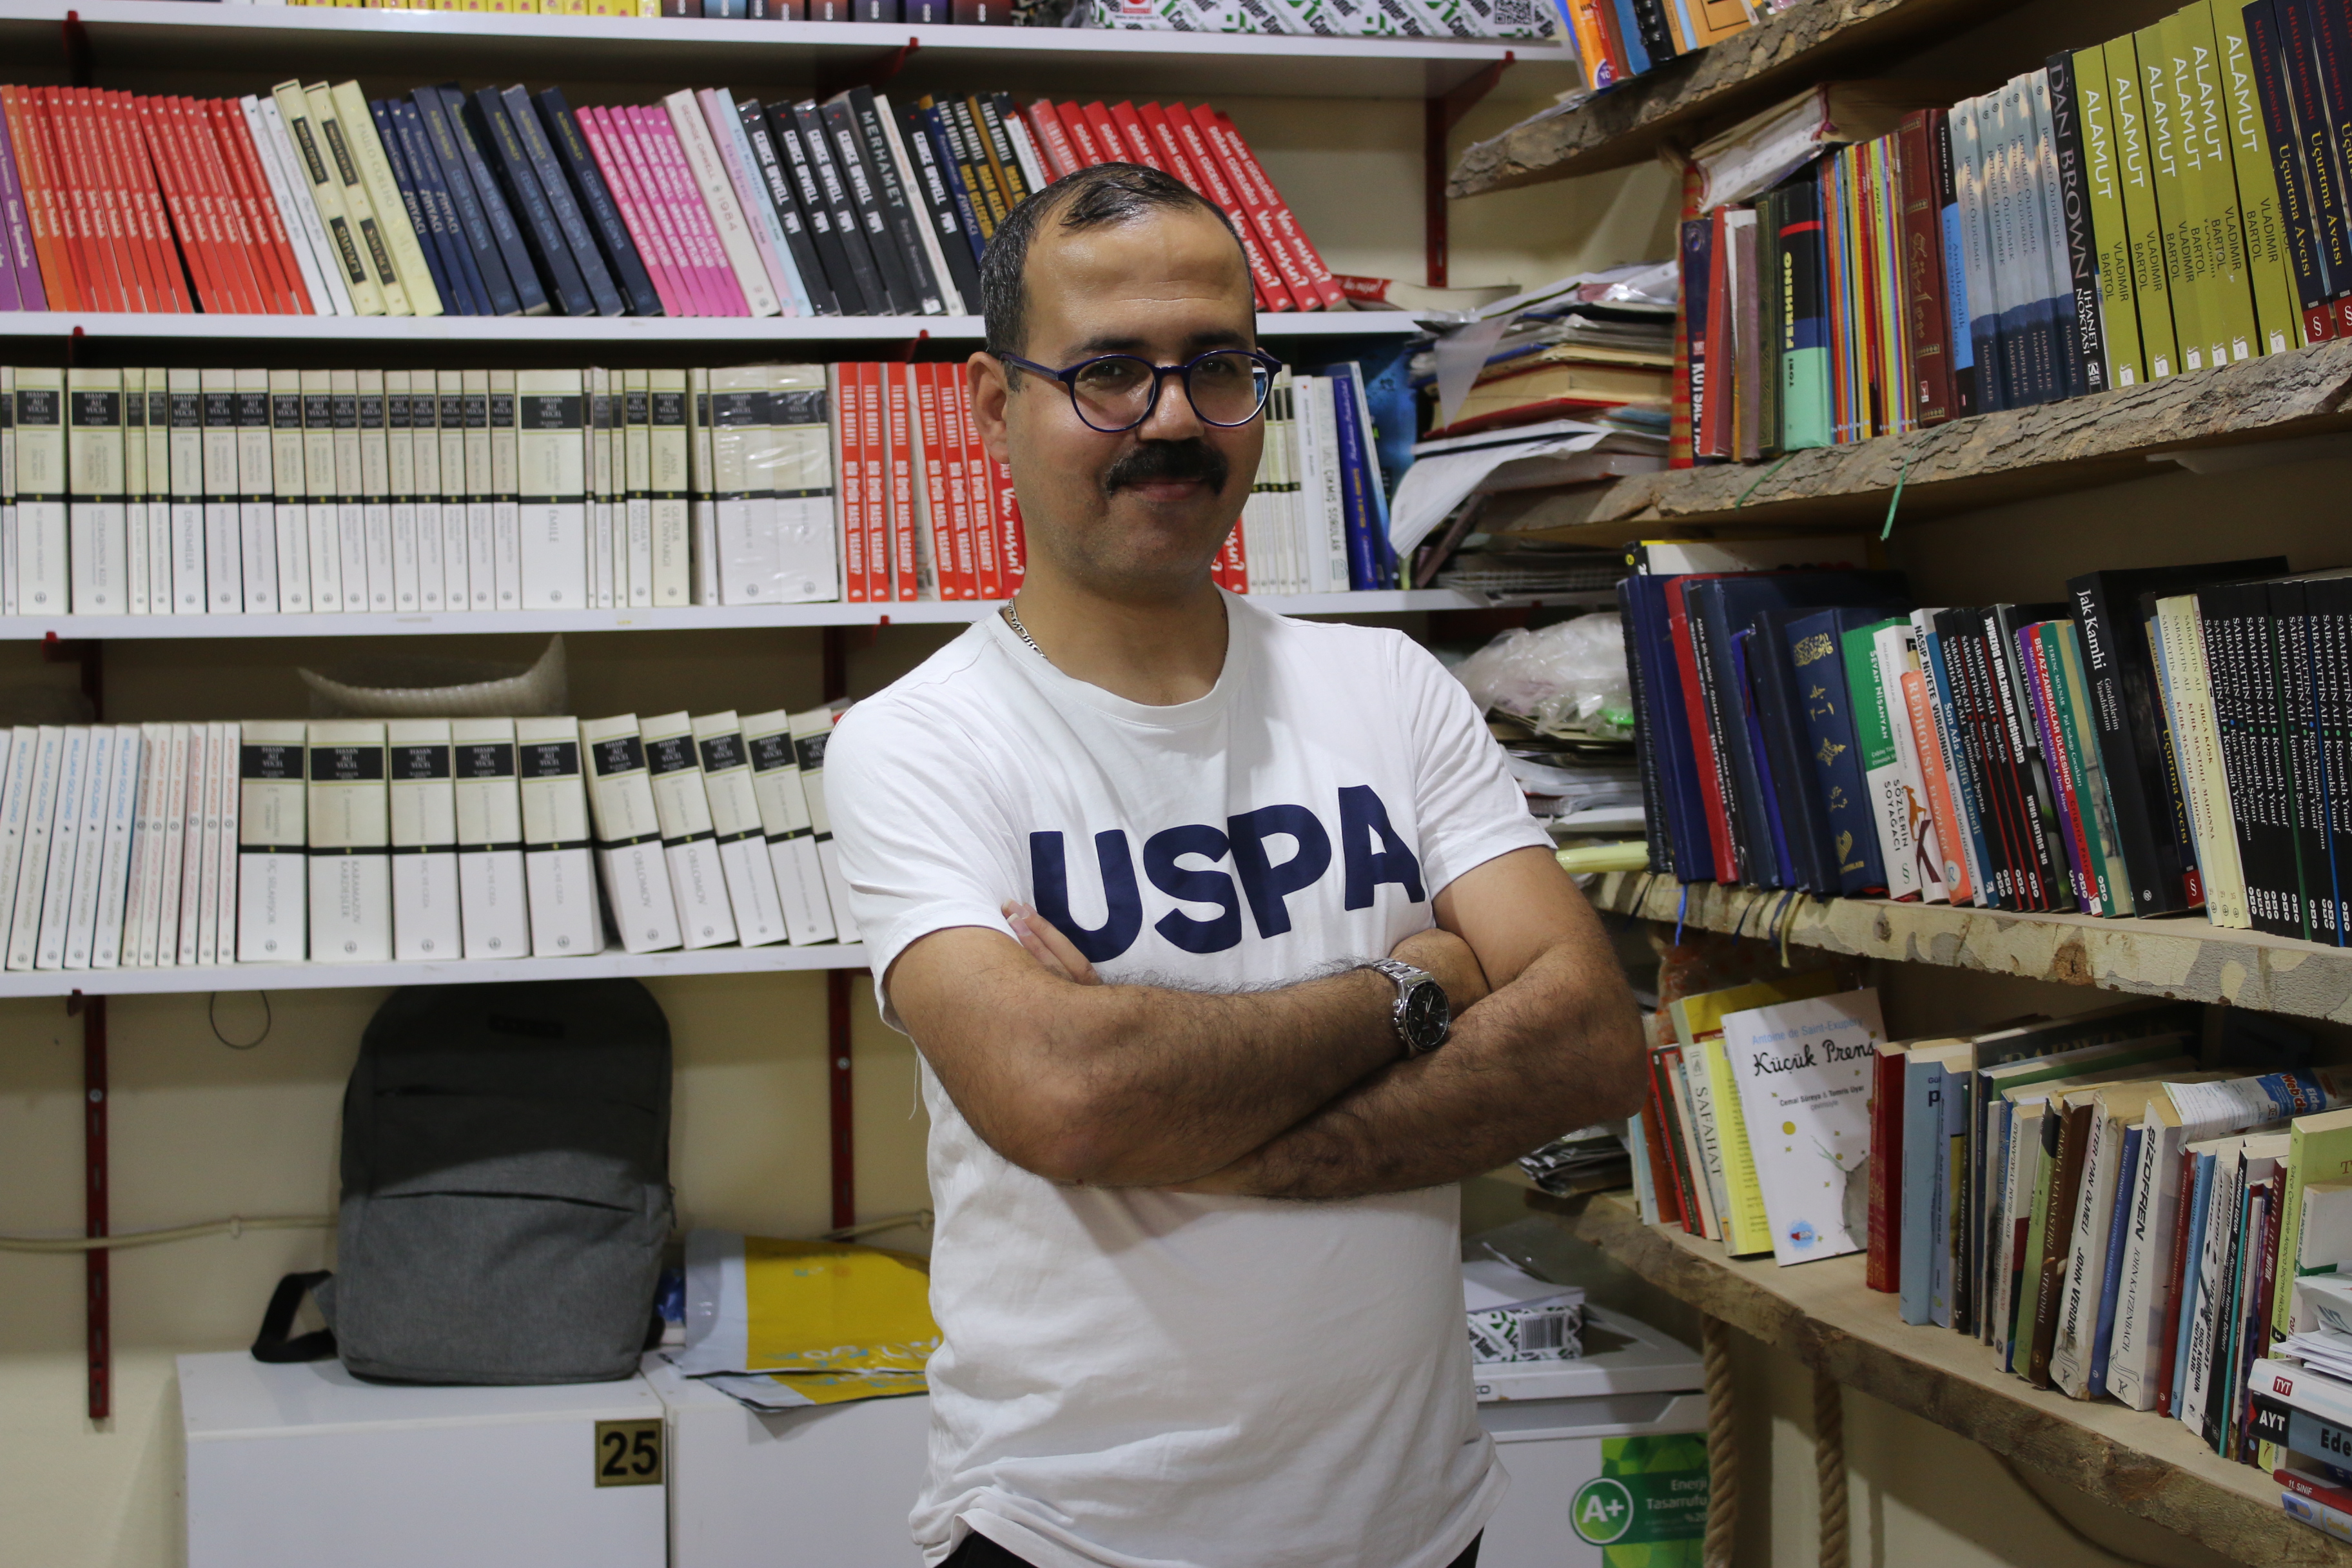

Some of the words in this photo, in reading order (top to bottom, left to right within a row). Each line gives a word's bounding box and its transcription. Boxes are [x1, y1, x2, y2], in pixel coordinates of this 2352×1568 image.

[2226, 35, 2257, 152] ALAMUT
[2255, 20, 2271, 73] KHALED
[2266, 75, 2282, 132] HOSSEINI
[2288, 6, 2304, 59] KHALED
[2298, 62, 2315, 121] HOSSEINI
[2050, 61, 2072, 138] DAN
[2148, 66, 2175, 177] ALAMUT
[2173, 58, 2201, 170] ALAMUT
[2193, 46, 2222, 161] ALAMUT
[861, 111, 904, 208] MERHAMET
[2086, 90, 2112, 199] ALAMUT
[2117, 78, 2144, 187] ALAMUT
[2280, 143, 2299, 221] Uçurtma
[2312, 131, 2331, 209] Uçurtma
[2060, 148, 2089, 279] BROWN
[2211, 219, 2226, 270] BARTOL
[2225, 206, 2241, 271] VLADIMIR
[2247, 210, 2261, 262] BARTOL
[2260, 197, 2278, 263] VLADIMIR
[2101, 253, 2114, 301] BARTOL
[2113, 241, 2128, 302] VLADIMIR
[2166, 233, 2180, 282] BARTOL
[2179, 220, 2195, 283] VLADIMIR
[2041, 330, 2051, 370] HARPER
[2065, 325, 2075, 366] HARPER
[2075, 288, 2090, 355] NOKTASI
[2083, 290, 2098, 350] İHANET
[2076, 589, 2095, 616] Jak
[1984, 616, 2001, 658] BOZMAK
[2084, 616, 2107, 671] Kamhi
[2277, 620, 2291, 698] SABAHATTİN
[1908, 681, 1936, 779] REDHOUSE
[2034, 637, 2048, 672] BEYAZ
[2041, 671, 2061, 732] ZAMBAKLAR
[2055, 734, 2073, 792] ÜLKESİNDE
[2096, 680, 2111, 731] Yaşadıklarım
[2104, 678, 2119, 730] Gördüklerim
[2204, 620, 2223, 700] SABAHATTİN
[2218, 703, 2228, 723] ALİ
[2223, 735, 2236, 787] Kuyucaklı
[2233, 790, 2244, 823] Yusuf
[2286, 701, 2295, 721] ALİ
[1944, 703, 1953, 726] Son
[1950, 728, 1961, 750] Ada
[1963, 788, 1981, 835] Livaneli
[2290, 734, 2302, 790] İçimizdeki
[1893, 779, 1908, 847] SÖZLERİN
[2296, 792, 2305, 828] Şeytan
[1029, 785, 1425, 963] USPA
[1752, 1032, 1785, 1045] Antoine
[1788, 1028, 1799, 1038] de
[1753, 1044, 1818, 1076] Küçük
[1822, 1039, 1874, 1063] Prens
[1696, 1086, 1723, 1179] SAFAHAT
[2091, 1116, 2102, 1160] PETER
[2088, 1162, 2097, 1188] PAN
[2135, 1126, 2155, 1241] ŞİZOFREN
[2074, 1247, 2085, 1280] JOHN
[2065, 1283, 2081, 1340] VERDON
[2122, 1280, 2138, 1352] KATZENBACH
[2275, 1378, 2291, 1394] TYT
[2259, 1409, 2286, 1431] AYT
[601, 1431, 659, 1476] 25
[1582, 1494, 1625, 1524] A+
[2297, 1482, 2313, 1495] SINIF
